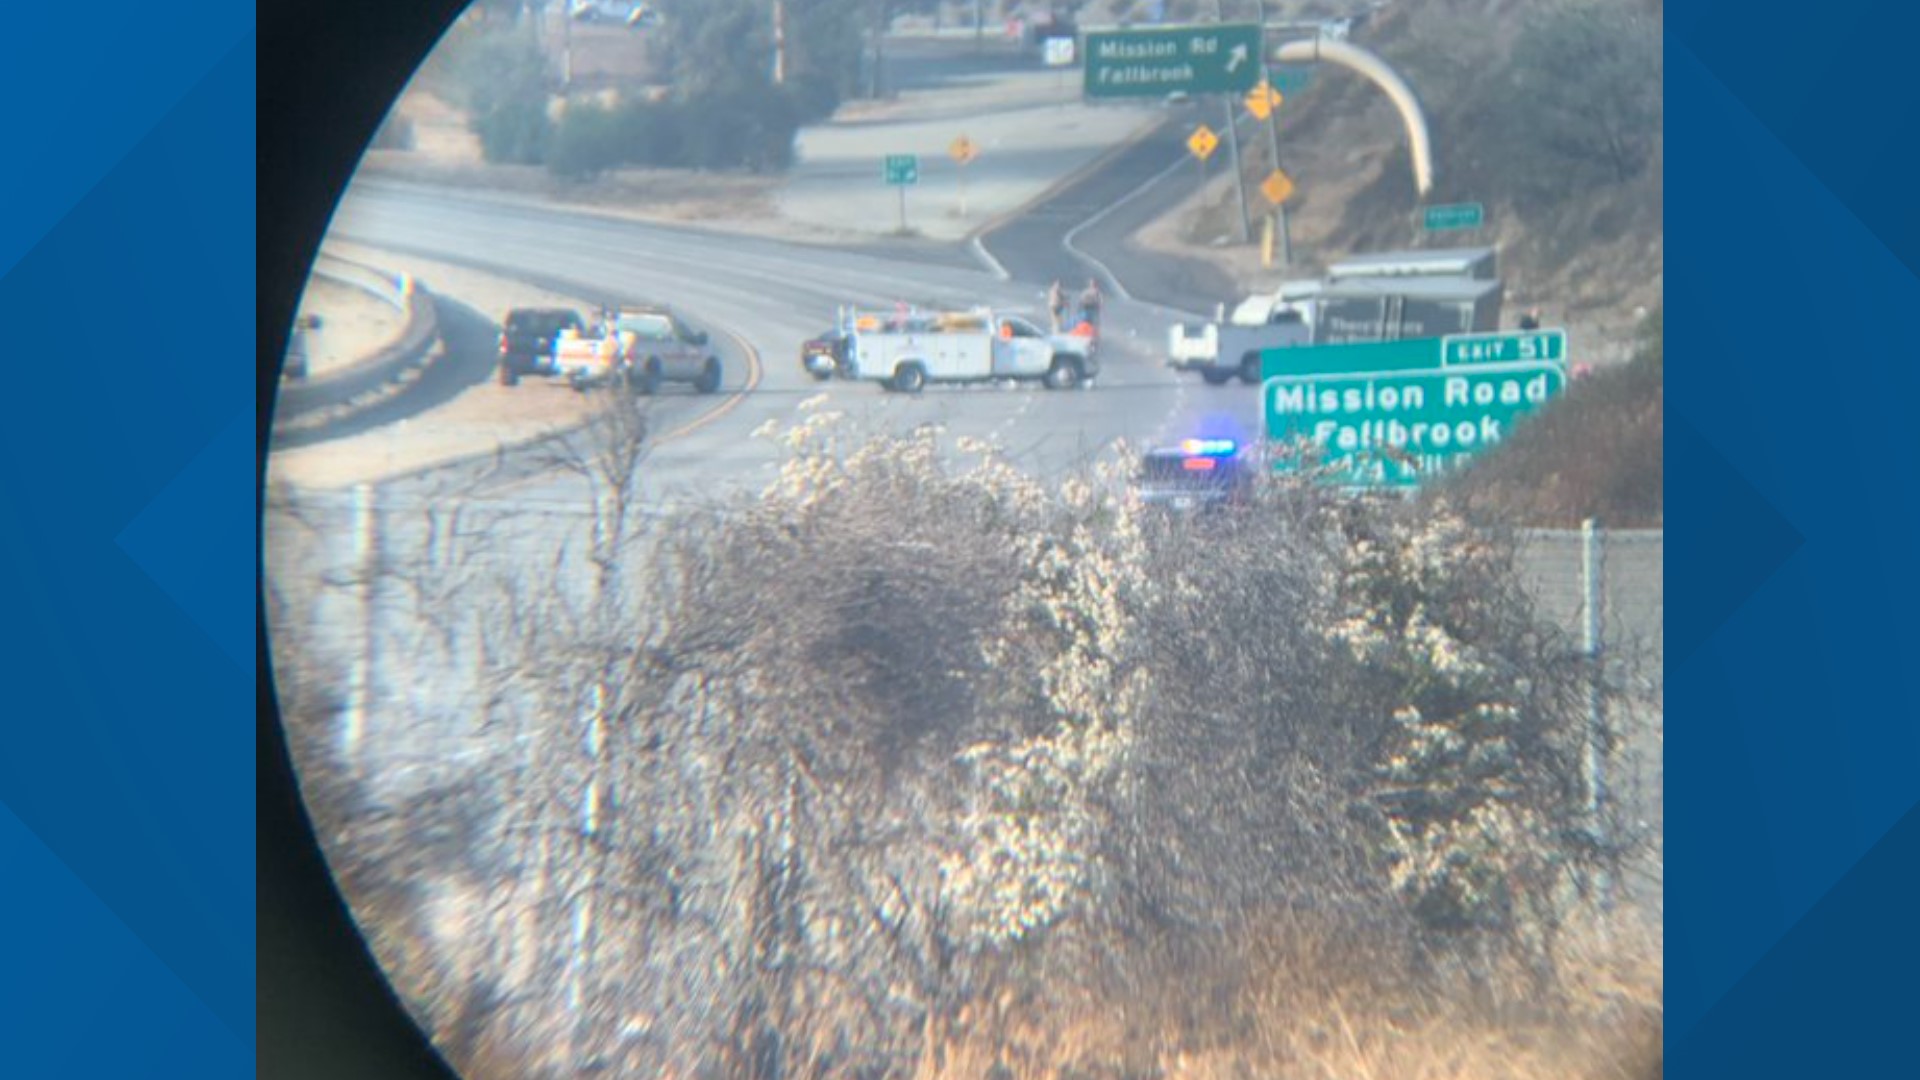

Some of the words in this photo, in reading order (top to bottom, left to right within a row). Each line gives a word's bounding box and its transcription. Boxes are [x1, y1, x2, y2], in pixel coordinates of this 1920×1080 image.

[1100, 41, 1177, 58] Mission
[1190, 37, 1218, 54] Rd
[1099, 65, 1193, 83] Fallbrook
[1457, 342, 1505, 359] EXIT
[1518, 336, 1549, 358] 51
[1275, 382, 1424, 414] Mission
[1444, 373, 1548, 407] Road
[1314, 415, 1500, 448] Fallbrook
